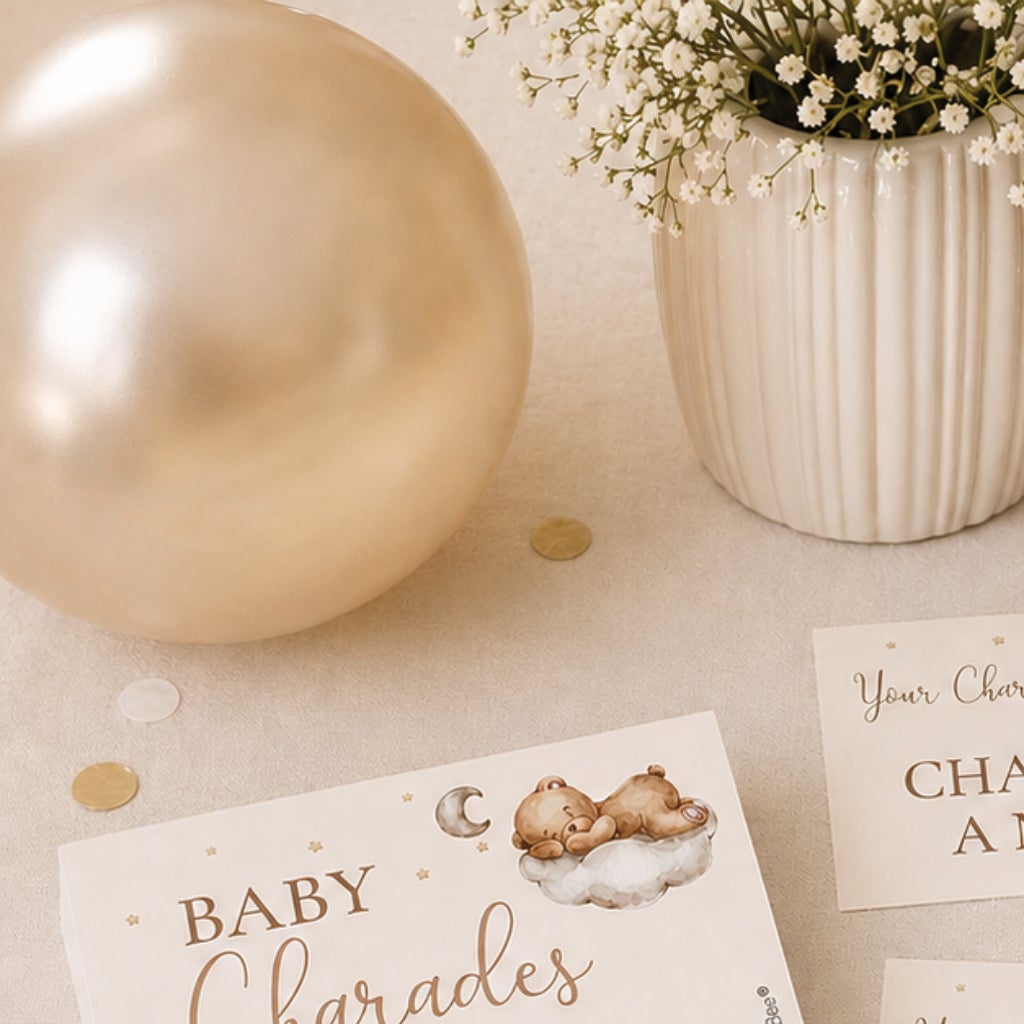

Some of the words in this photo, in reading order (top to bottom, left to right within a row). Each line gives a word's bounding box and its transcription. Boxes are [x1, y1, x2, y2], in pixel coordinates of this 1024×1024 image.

[853, 669, 940, 723] Your
[952, 815, 999, 856] A
[177, 865, 376, 946] BABY
